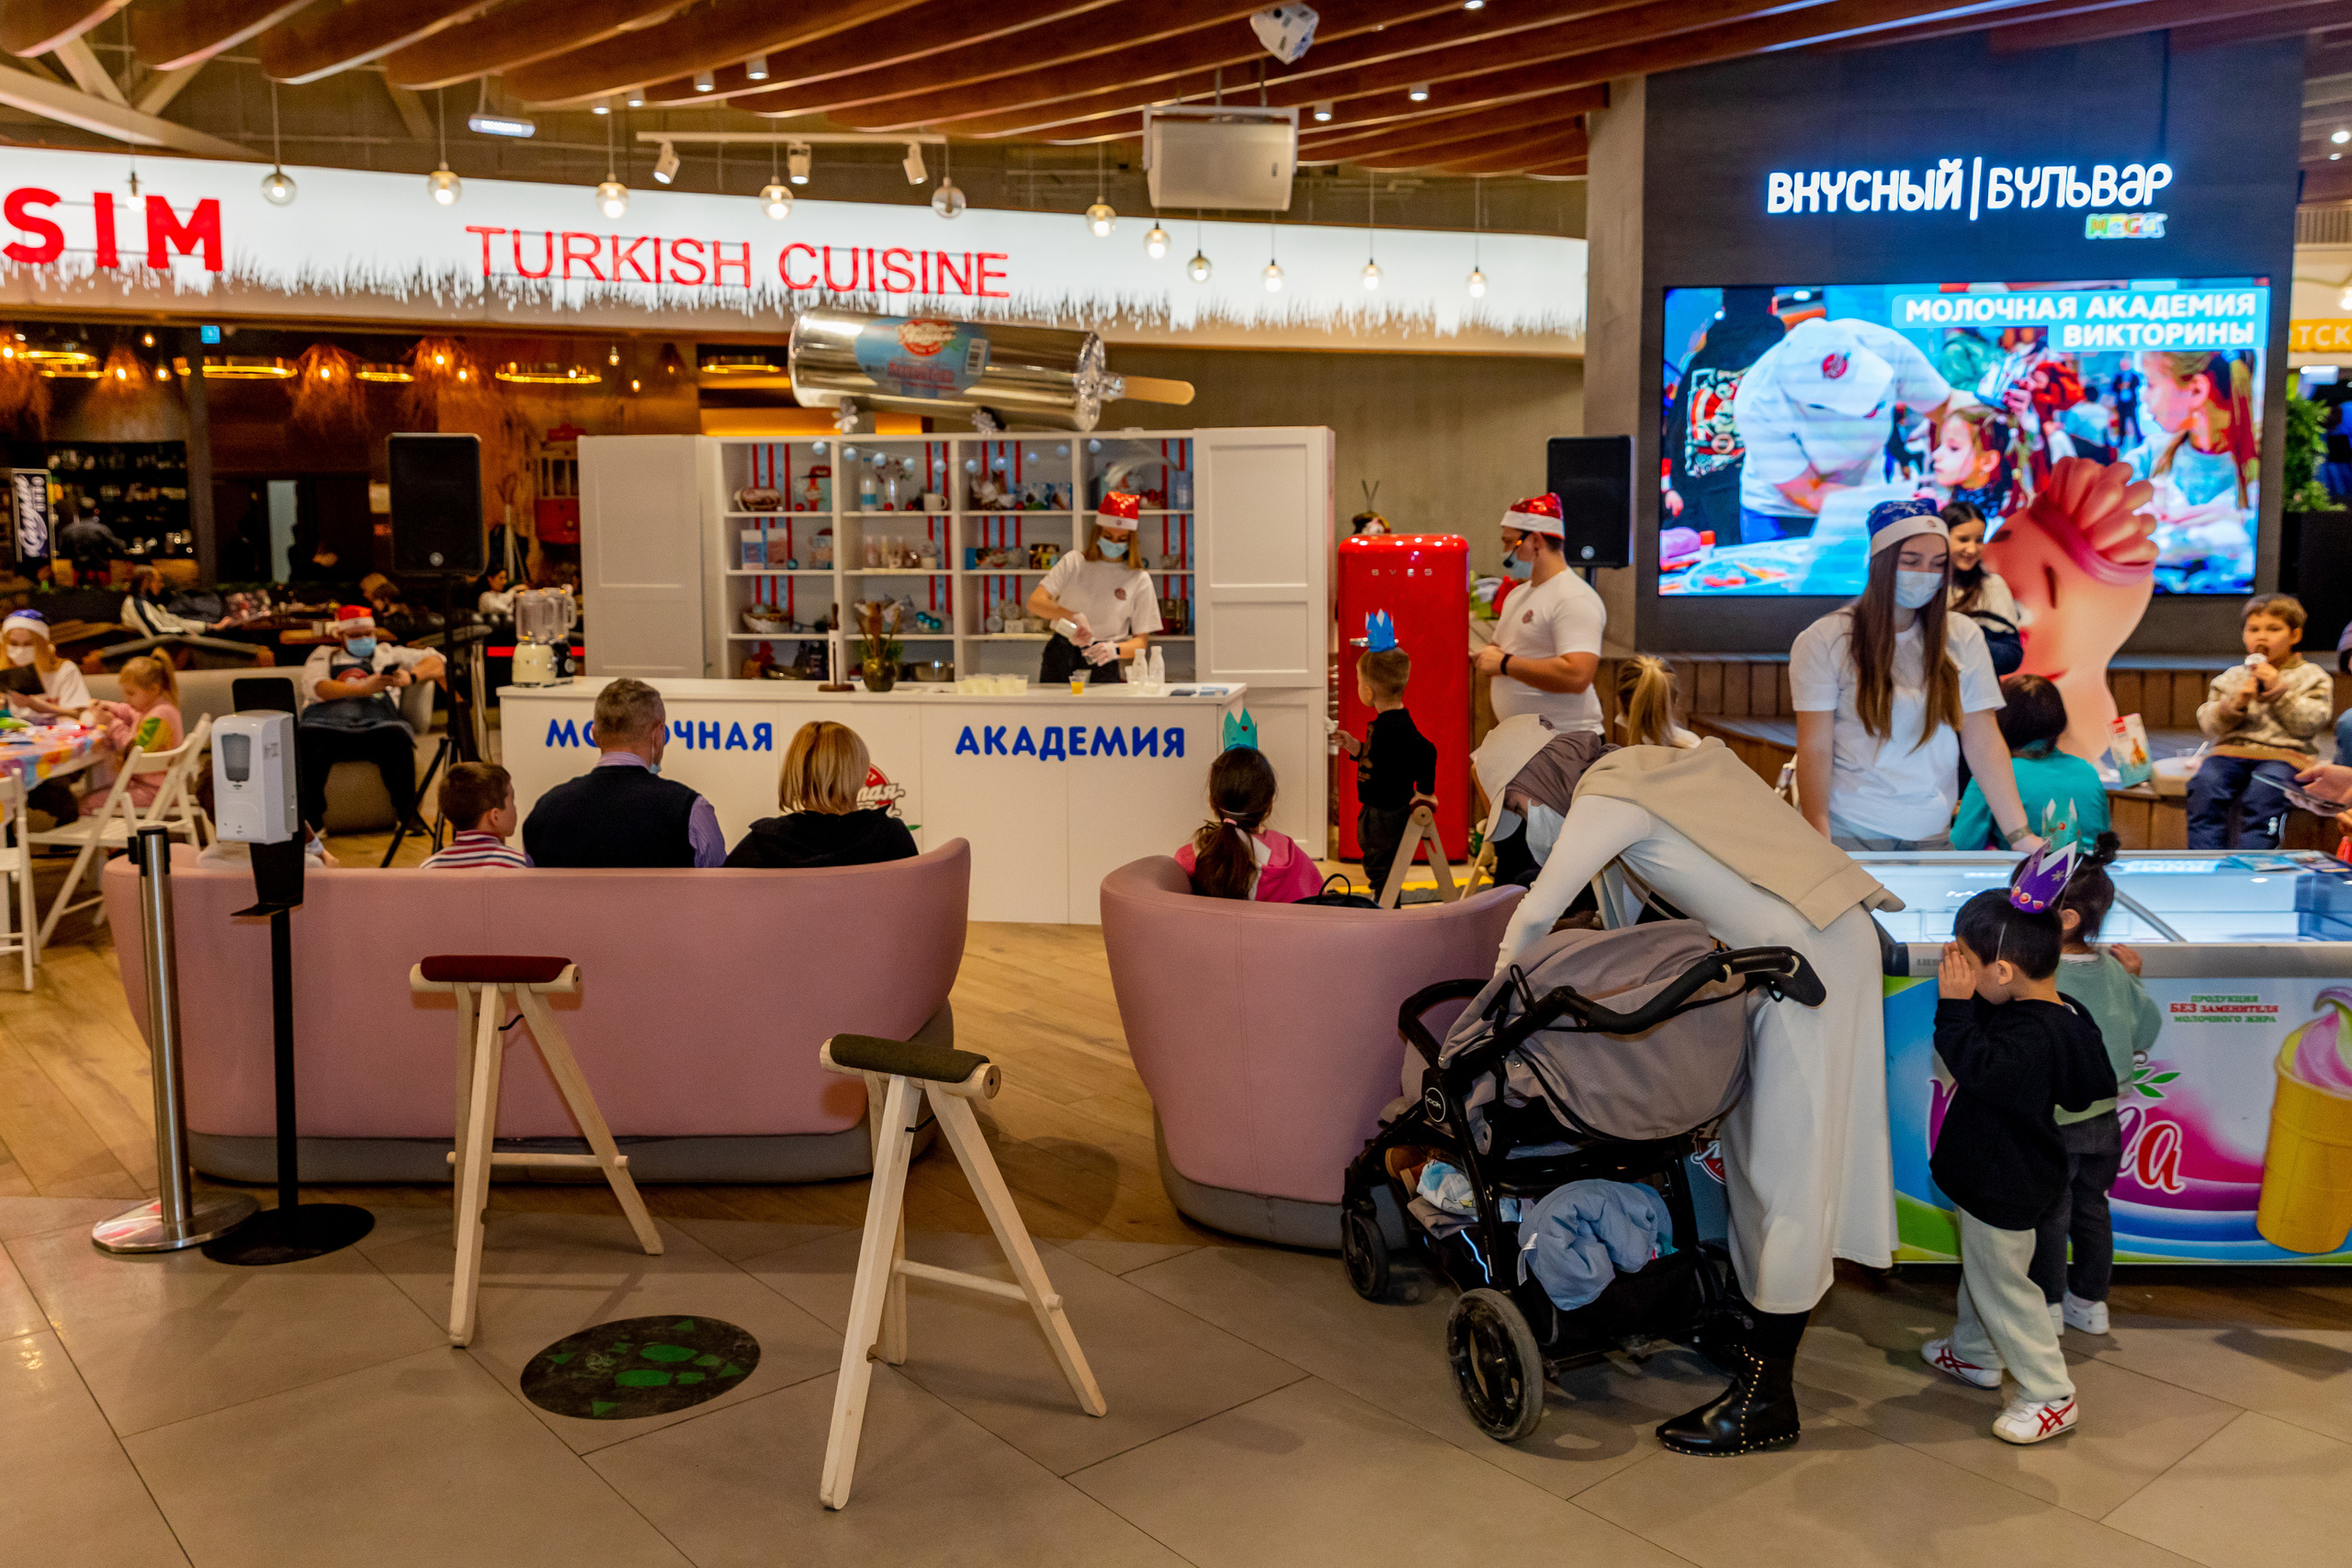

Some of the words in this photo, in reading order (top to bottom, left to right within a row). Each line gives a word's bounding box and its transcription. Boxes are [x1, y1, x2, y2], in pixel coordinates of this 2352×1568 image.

[1768, 158, 1964, 213] ВКУСНЫЙ
[3, 186, 223, 273] SIM
[465, 225, 751, 288] TURKISH
[778, 242, 1010, 299] CUISINE
[1905, 296, 2078, 323] МОЛОЧНАЯ
[2085, 292, 2256, 321] АКАДЕМИЯ
[2063, 321, 2256, 348] ВИКТОРИНЫ
[2289, 324, 2352, 346] ТСК
[955, 725, 1185, 761] АКАДЕМИЯ
[2169, 1002, 2197, 1013] БЕЗ
